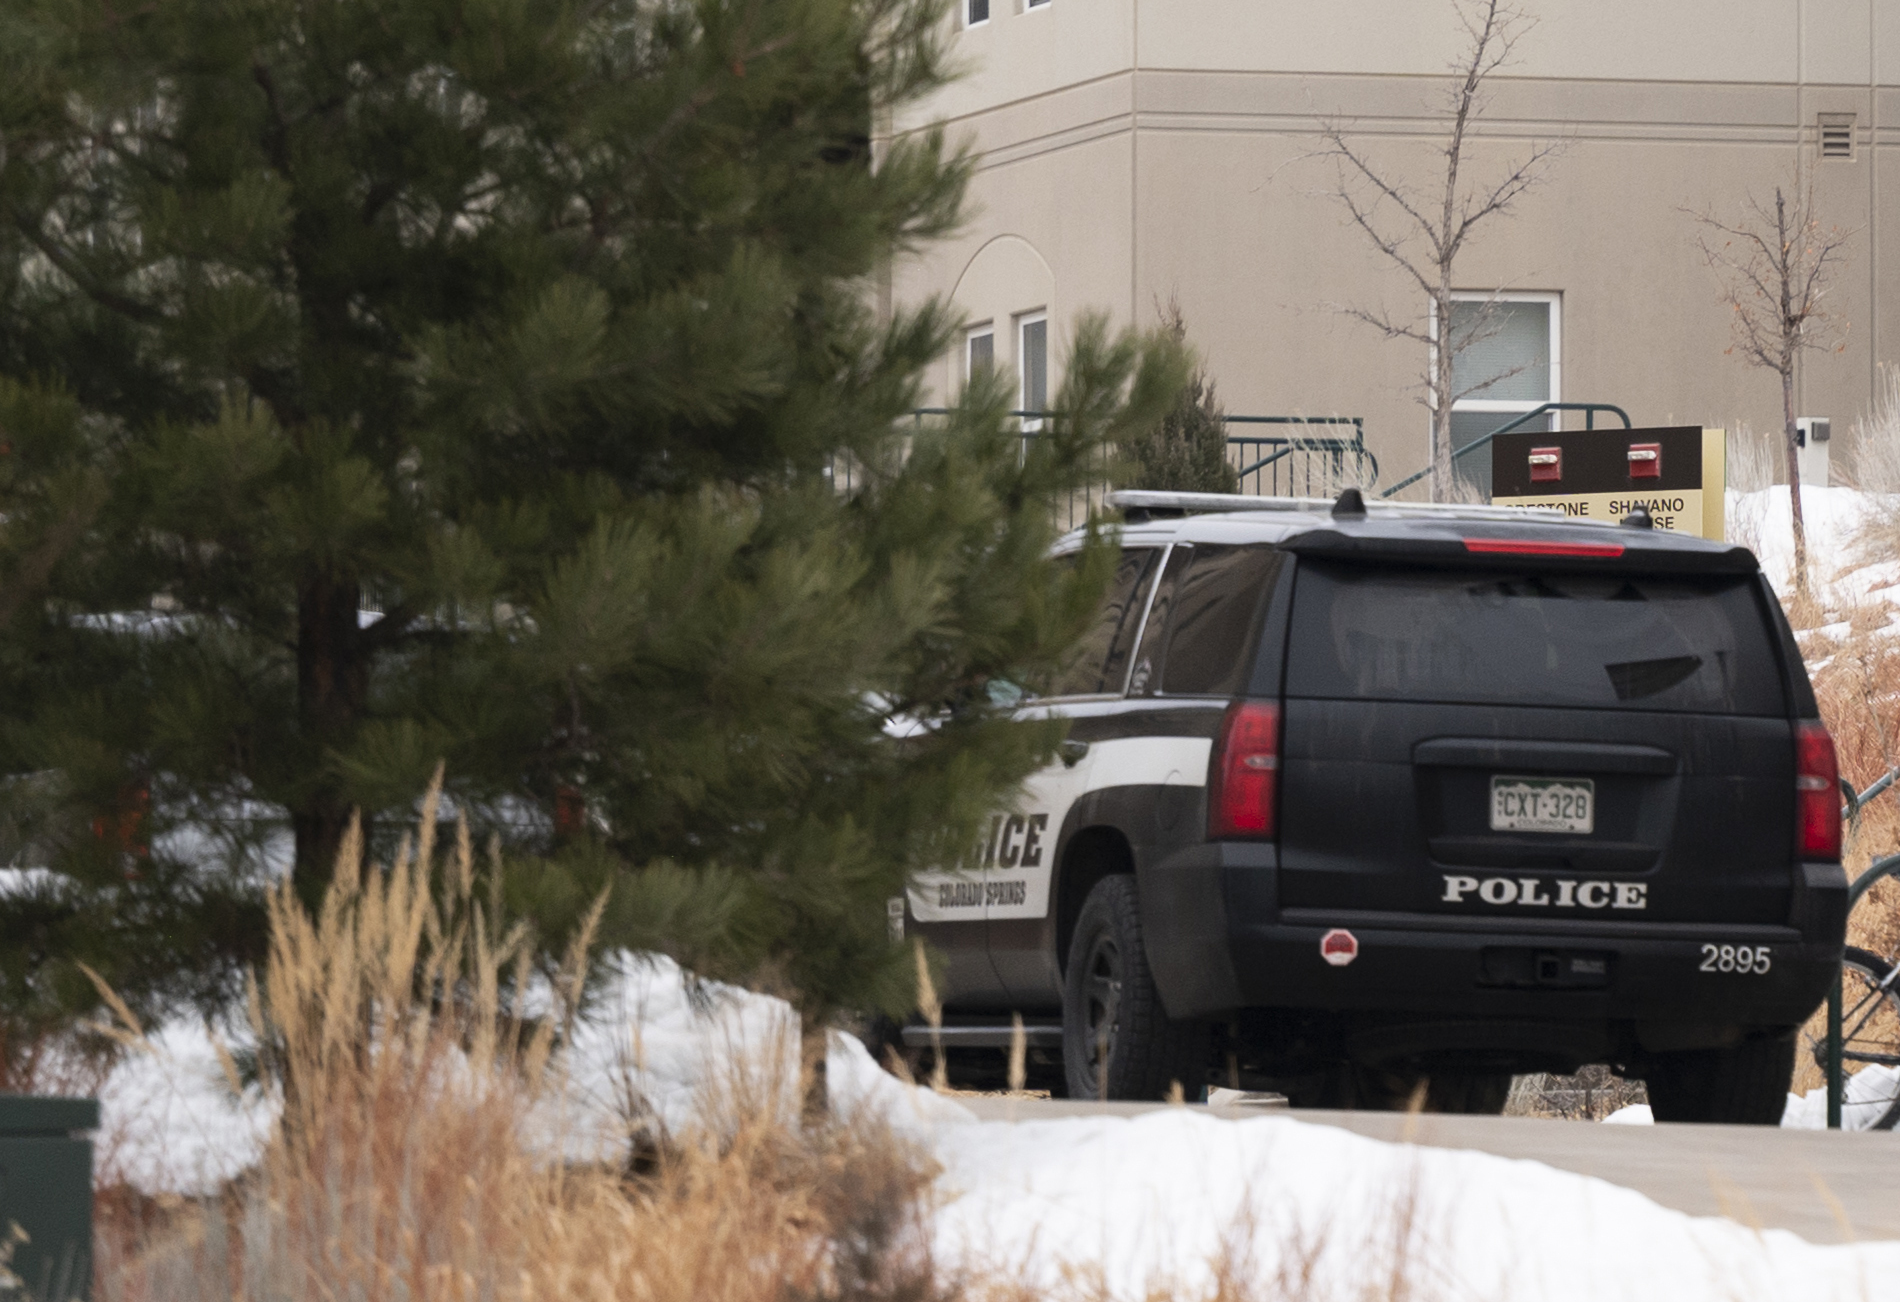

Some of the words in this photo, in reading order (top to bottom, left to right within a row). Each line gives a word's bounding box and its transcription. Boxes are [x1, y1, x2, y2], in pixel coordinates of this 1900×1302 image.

[939, 883, 981, 907] COLORADO
[986, 881, 1026, 905] SPRINGS
[1442, 875, 1647, 909] POLICE
[1699, 944, 1771, 974] 2895
